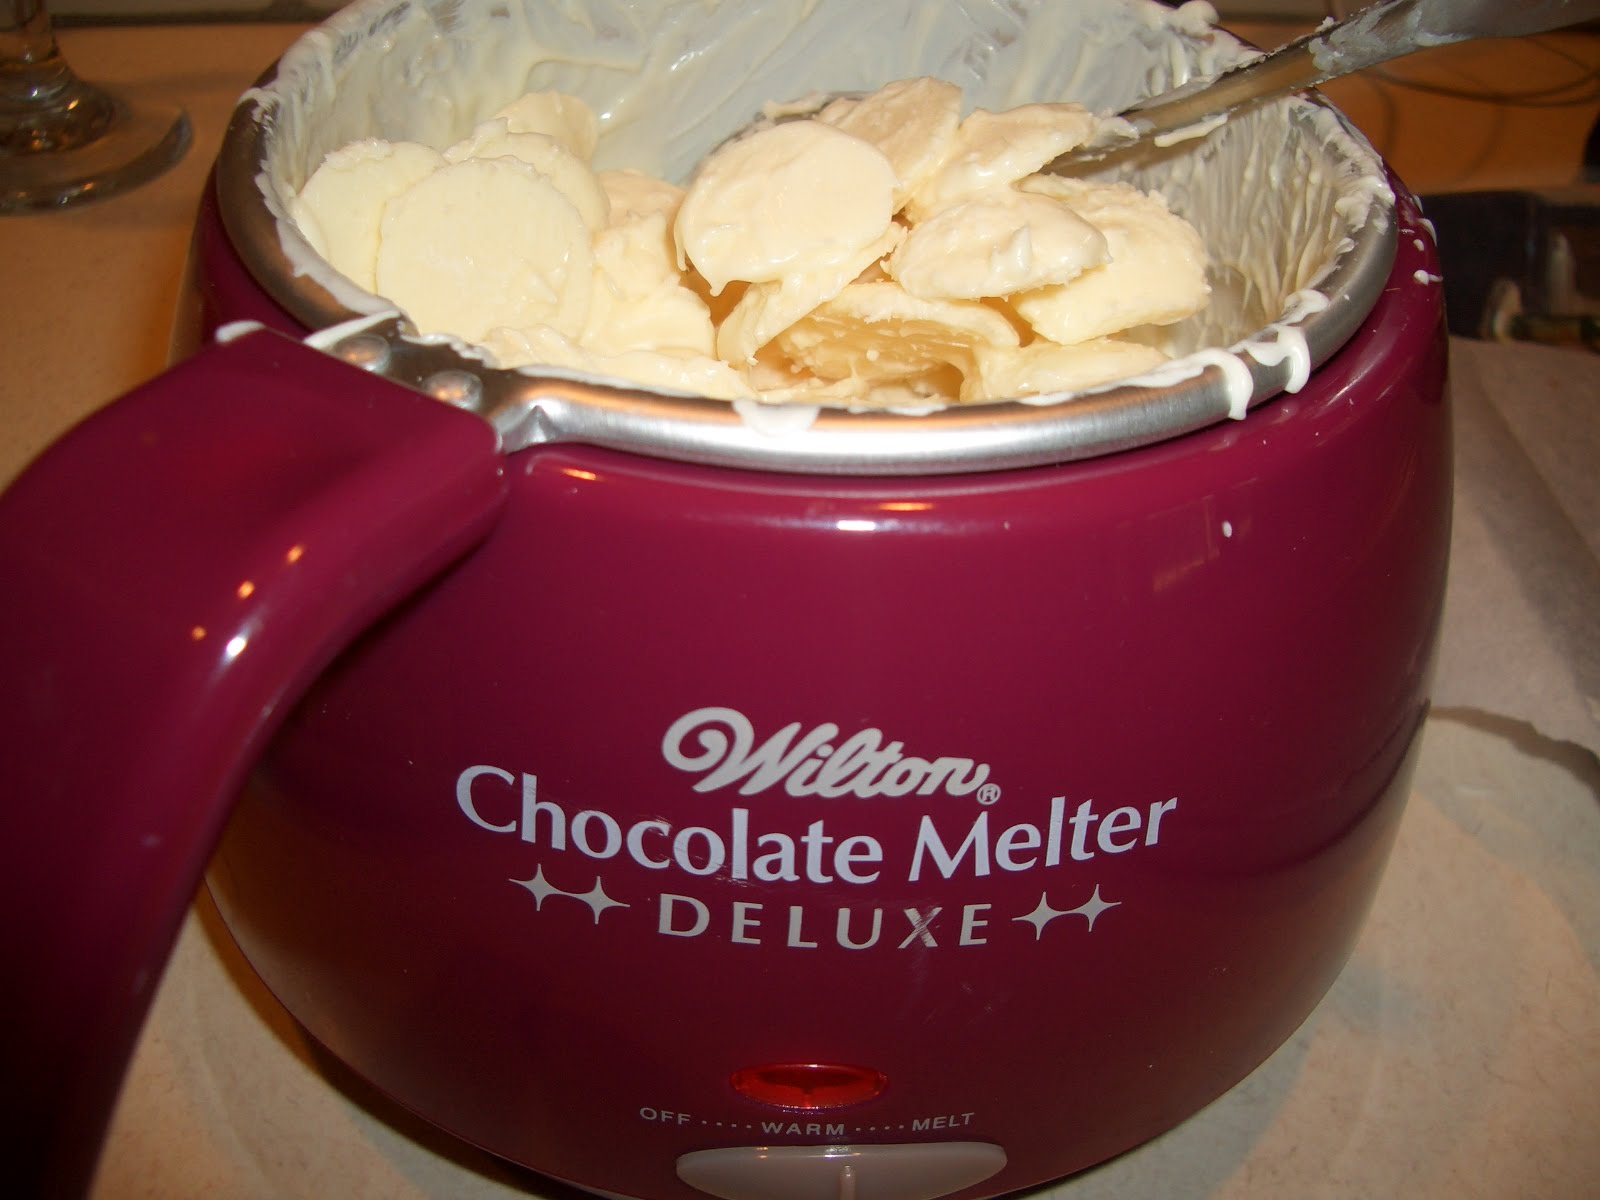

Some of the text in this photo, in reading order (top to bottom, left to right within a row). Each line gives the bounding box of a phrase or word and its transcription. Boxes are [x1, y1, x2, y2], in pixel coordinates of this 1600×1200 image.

[662, 707, 991, 799] Wilton
[456, 764, 1178, 884] Chocolate Melter
[658, 893, 992, 950] DELUXE
[639, 1107, 976, 1137] OFF WARM MELT
